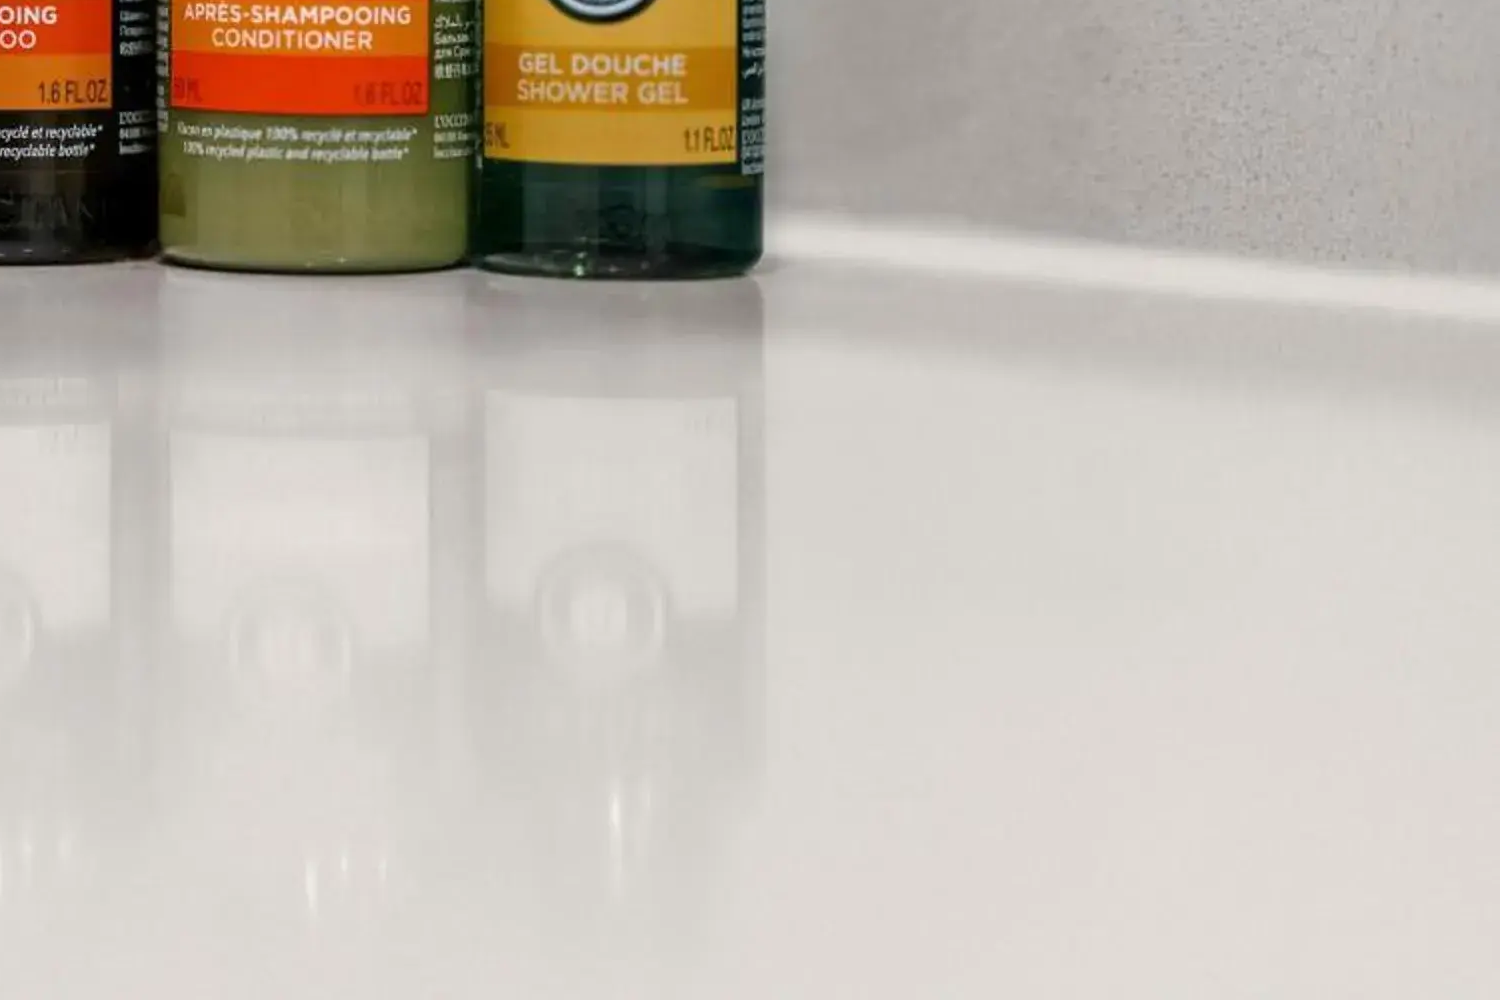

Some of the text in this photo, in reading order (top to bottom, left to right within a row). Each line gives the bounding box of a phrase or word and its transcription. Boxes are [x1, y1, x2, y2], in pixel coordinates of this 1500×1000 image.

[211, 28, 372, 50] CONDITIONER
[518, 52, 687, 76] GEL DOUCHE
[38, 79, 61, 105] 1.6
[517, 79, 689, 104] SHOWER GEL
[31, 126, 43, 139] et
[265, 126, 299, 140] 100%
[0, 143, 56, 161] recyclable
